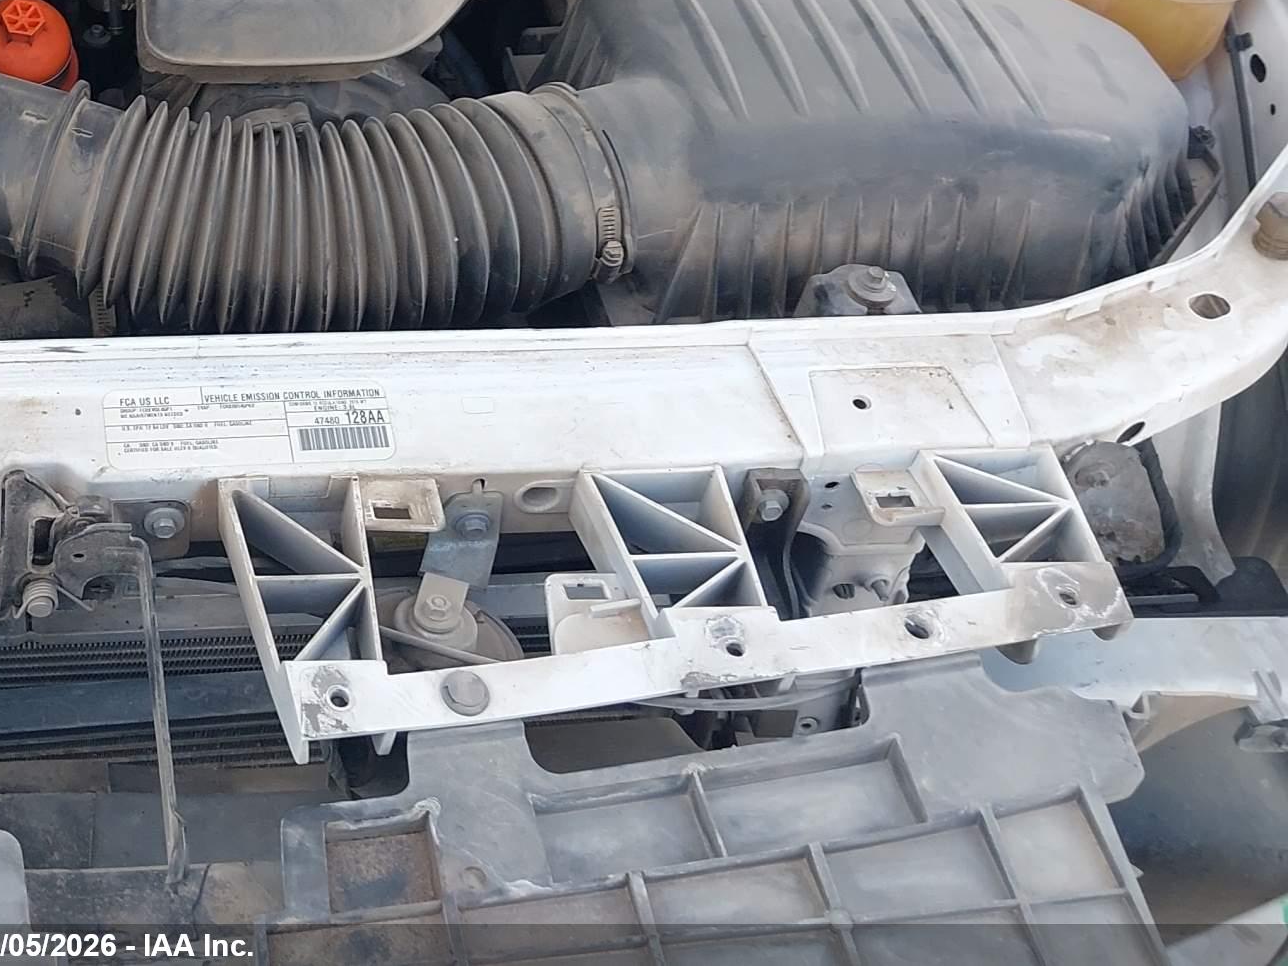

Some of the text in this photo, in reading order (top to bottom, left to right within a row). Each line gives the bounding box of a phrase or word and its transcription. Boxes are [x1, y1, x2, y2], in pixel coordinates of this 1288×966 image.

[119, 396, 170, 406] FCA US LLC
[204, 388, 380, 403] VEHICLE EMISSION CONTROL INFORMATION
[314, 410, 385, 425] 47480 128AA
